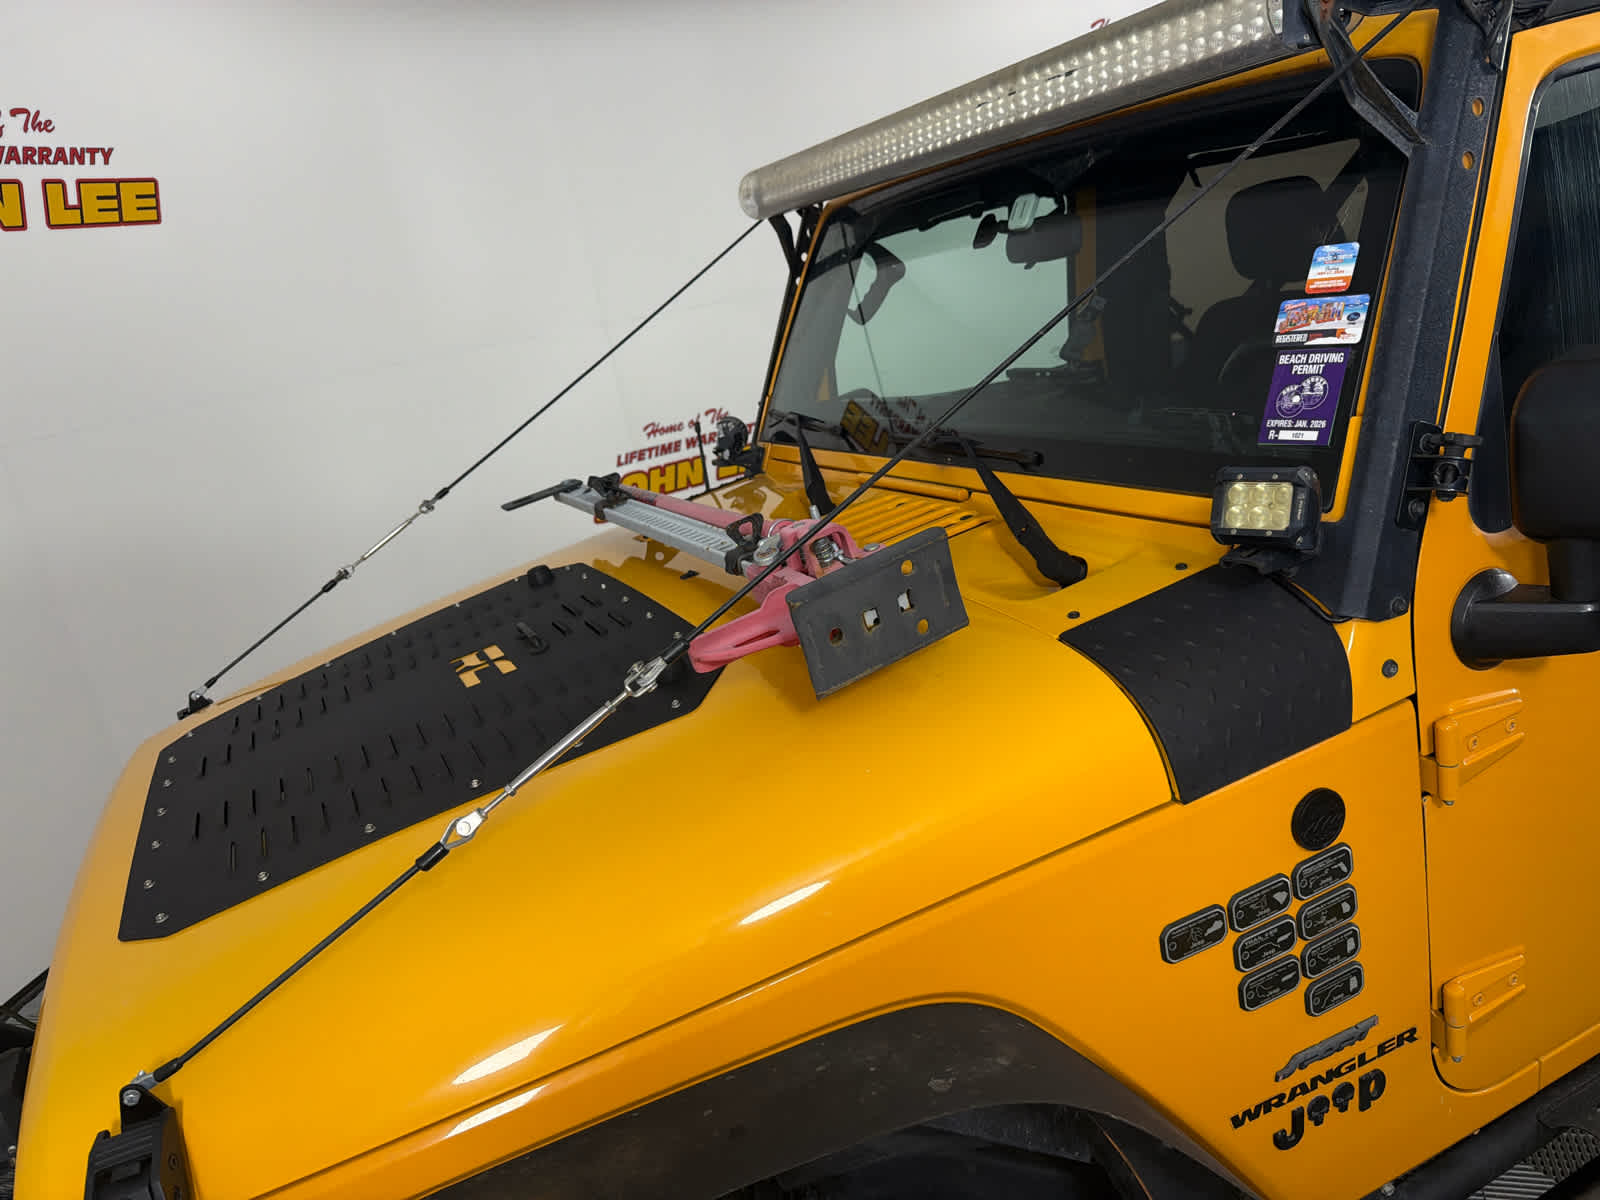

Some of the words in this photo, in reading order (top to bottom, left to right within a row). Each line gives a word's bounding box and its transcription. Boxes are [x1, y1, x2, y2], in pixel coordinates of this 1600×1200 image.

[9, 107, 56, 133] The
[0, 146, 114, 165] ARRANTY
[41, 177, 161, 230] LEE
[1278, 353, 1307, 365] BEACH
[1308, 352, 1345, 364] DRIVING
[1291, 364, 1325, 375] PERMIT
[643, 422, 685, 440] Home
[1294, 419, 1308, 428] JAN.
[616, 440, 682, 467] LIFETIME
[619, 455, 706, 494] OHN
[1230, 1027, 1418, 1130] WRANGLER
